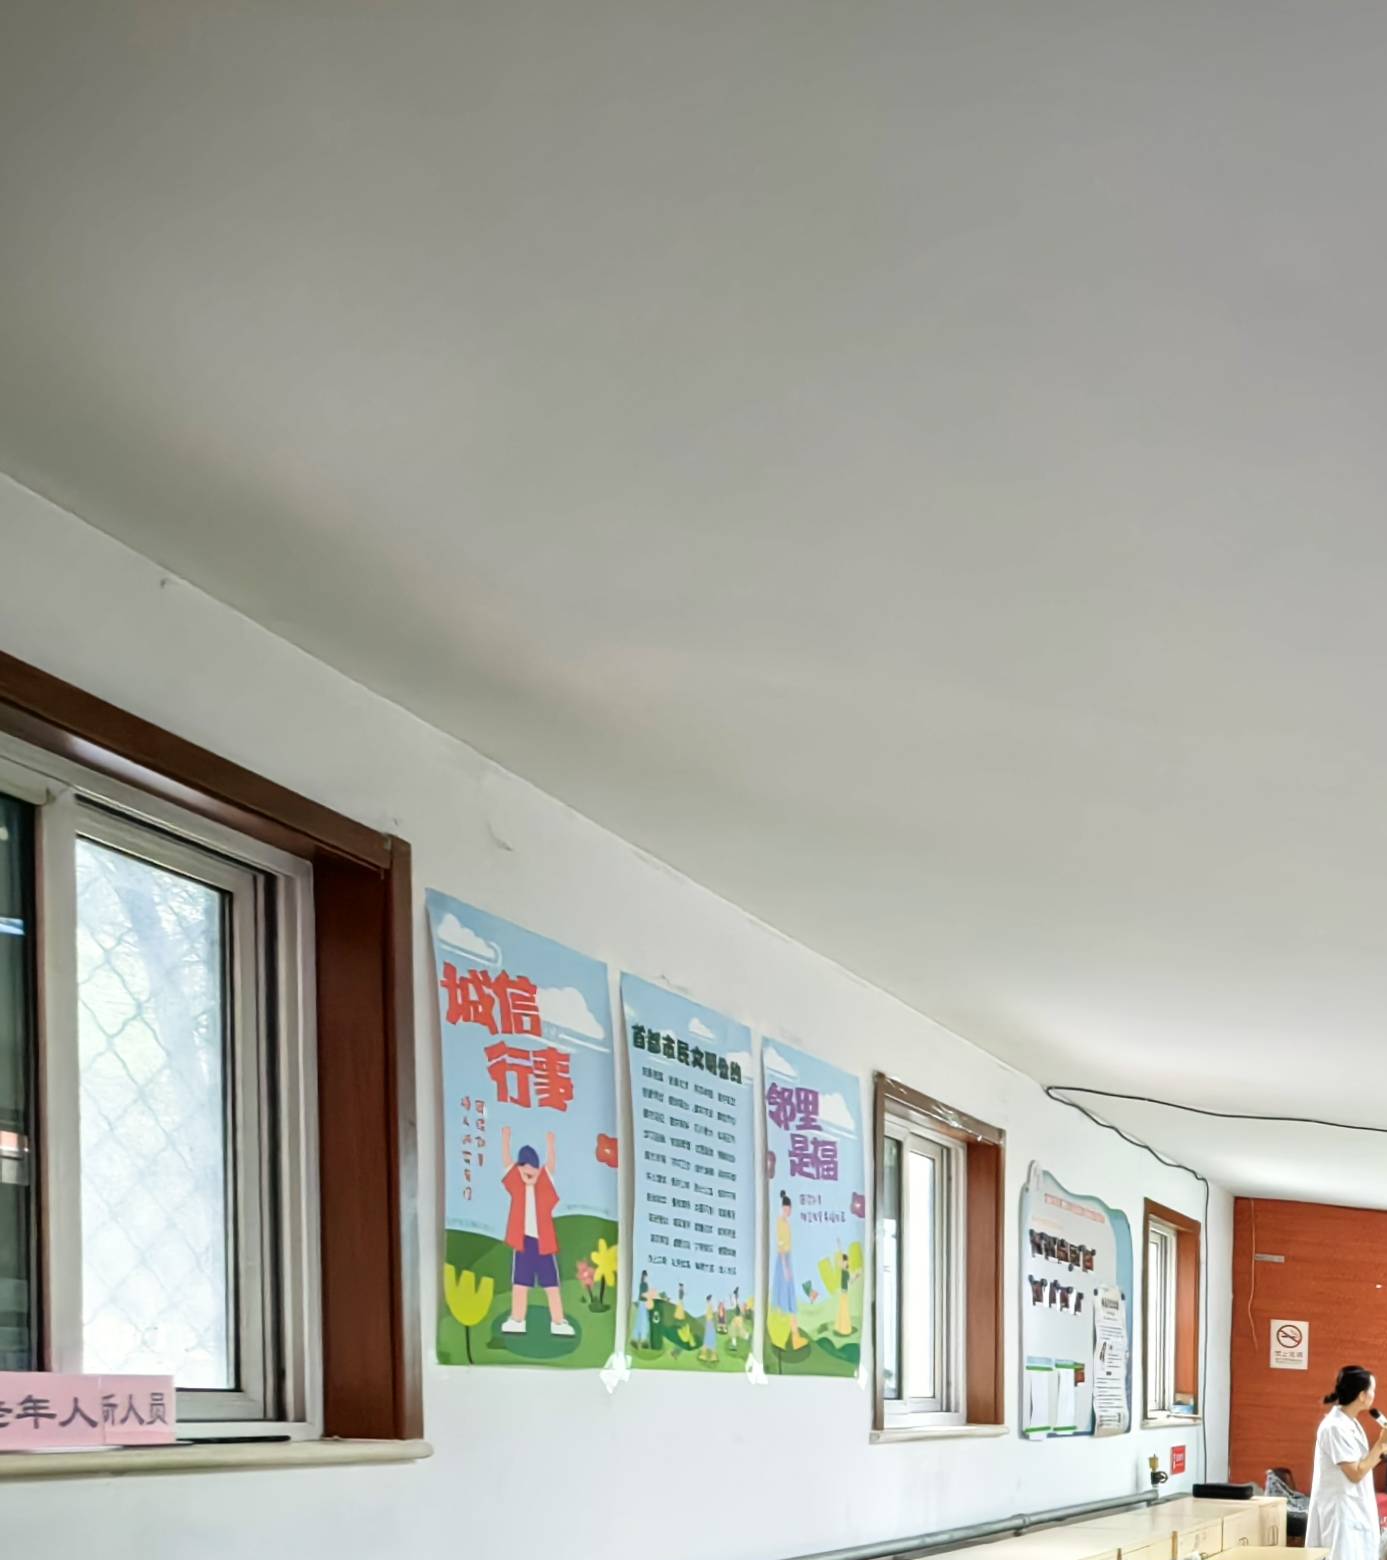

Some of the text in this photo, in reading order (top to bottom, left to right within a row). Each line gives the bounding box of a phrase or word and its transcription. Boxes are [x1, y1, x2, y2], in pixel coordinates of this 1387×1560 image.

[440, 961, 542, 1037] 诚信
[484, 1041, 574, 1112] 行事
[632, 1023, 742, 1084] 首都市民文明公约
[767, 1082, 823, 1131] 邻里
[789, 1134, 838, 1181] 是福
